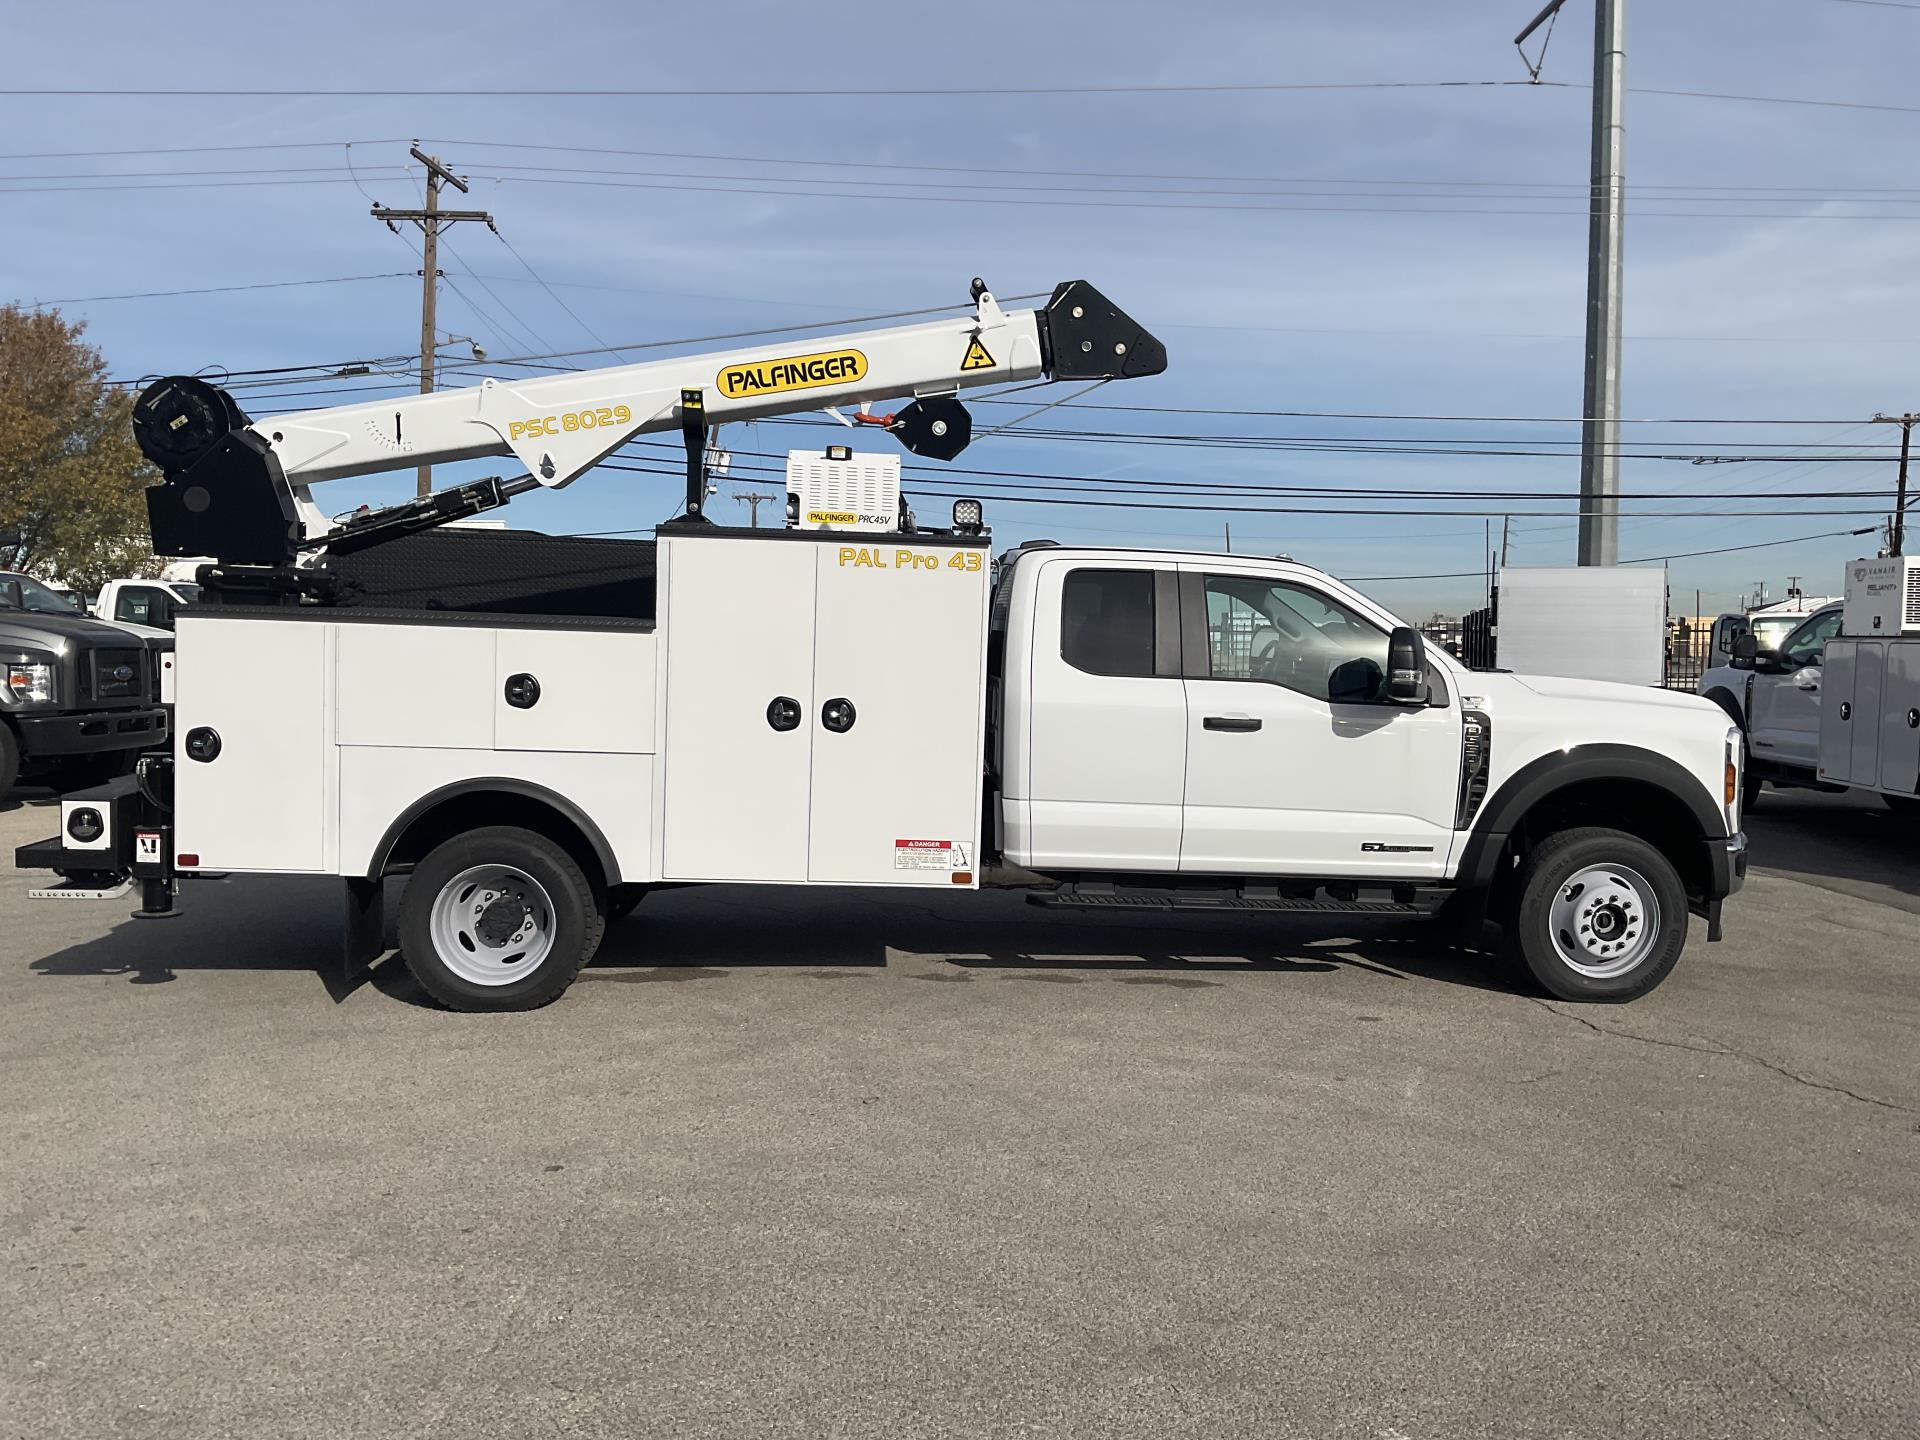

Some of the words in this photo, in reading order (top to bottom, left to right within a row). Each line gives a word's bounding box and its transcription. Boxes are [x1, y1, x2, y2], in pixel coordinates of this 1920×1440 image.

[727, 356, 859, 392] PALFINGER
[509, 416, 559, 440] PSC
[561, 405, 631, 431] 8029
[810, 513, 854, 522] PALFINGER
[857, 515, 891, 525] PRC45V
[839, 547, 887, 568] PAL
[895, 549, 938, 570] Pro
[947, 551, 982, 571] 43
[1868, 566, 1896, 575] VANAIR
